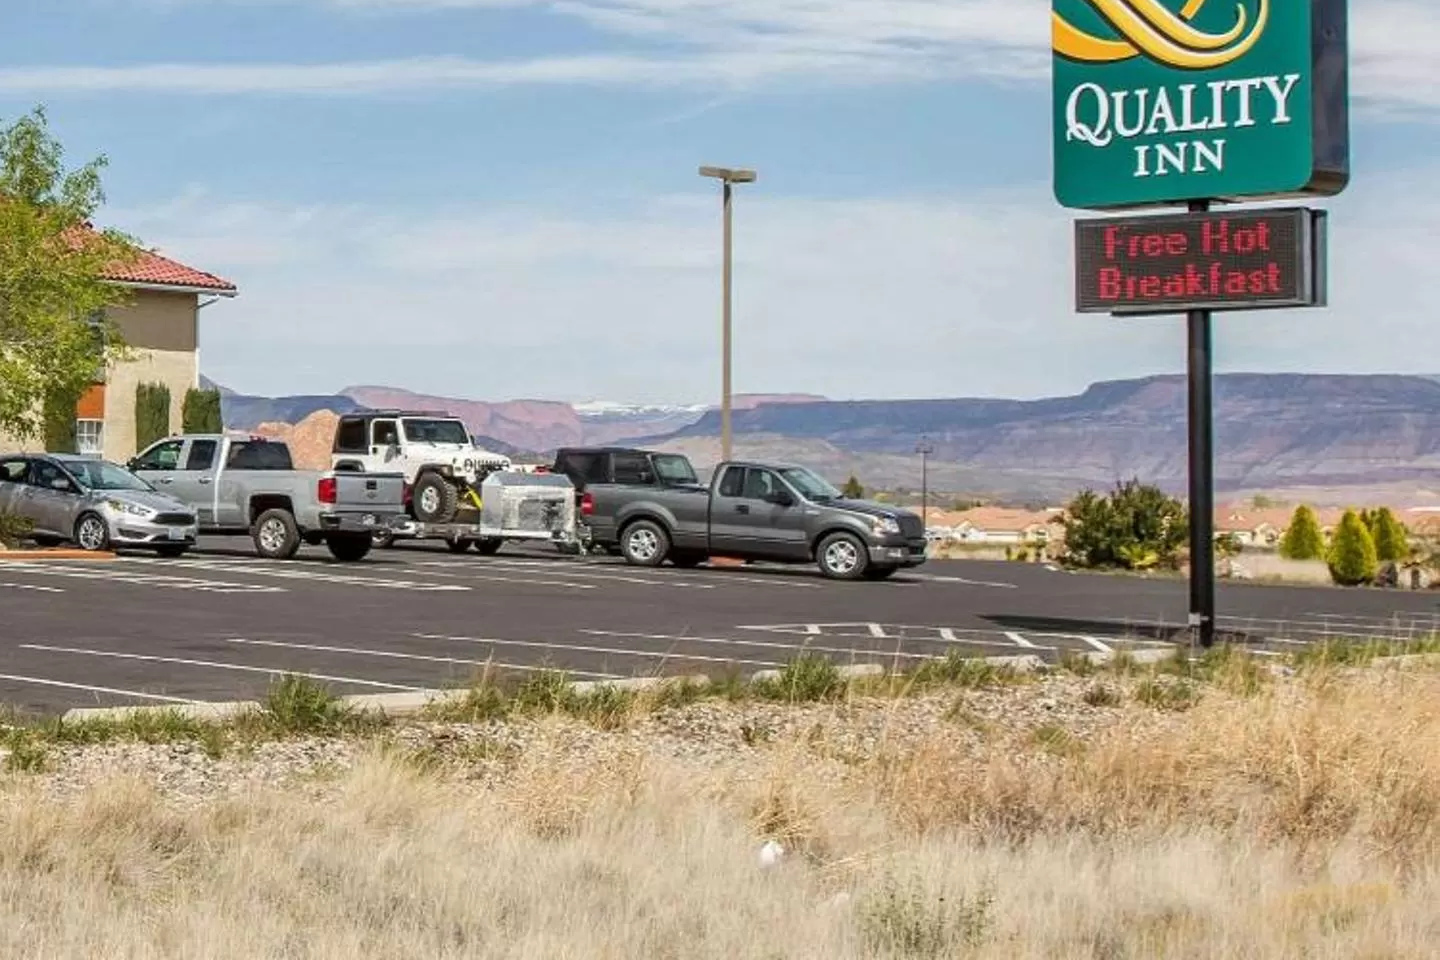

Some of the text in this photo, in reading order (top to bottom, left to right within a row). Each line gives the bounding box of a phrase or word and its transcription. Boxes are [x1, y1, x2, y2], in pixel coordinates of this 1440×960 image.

[1065, 73, 1300, 147] QUALITY
[1133, 139, 1226, 177] INN
[1104, 218, 1270, 260] Free Hot
[1098, 261, 1281, 300] Breakfast
